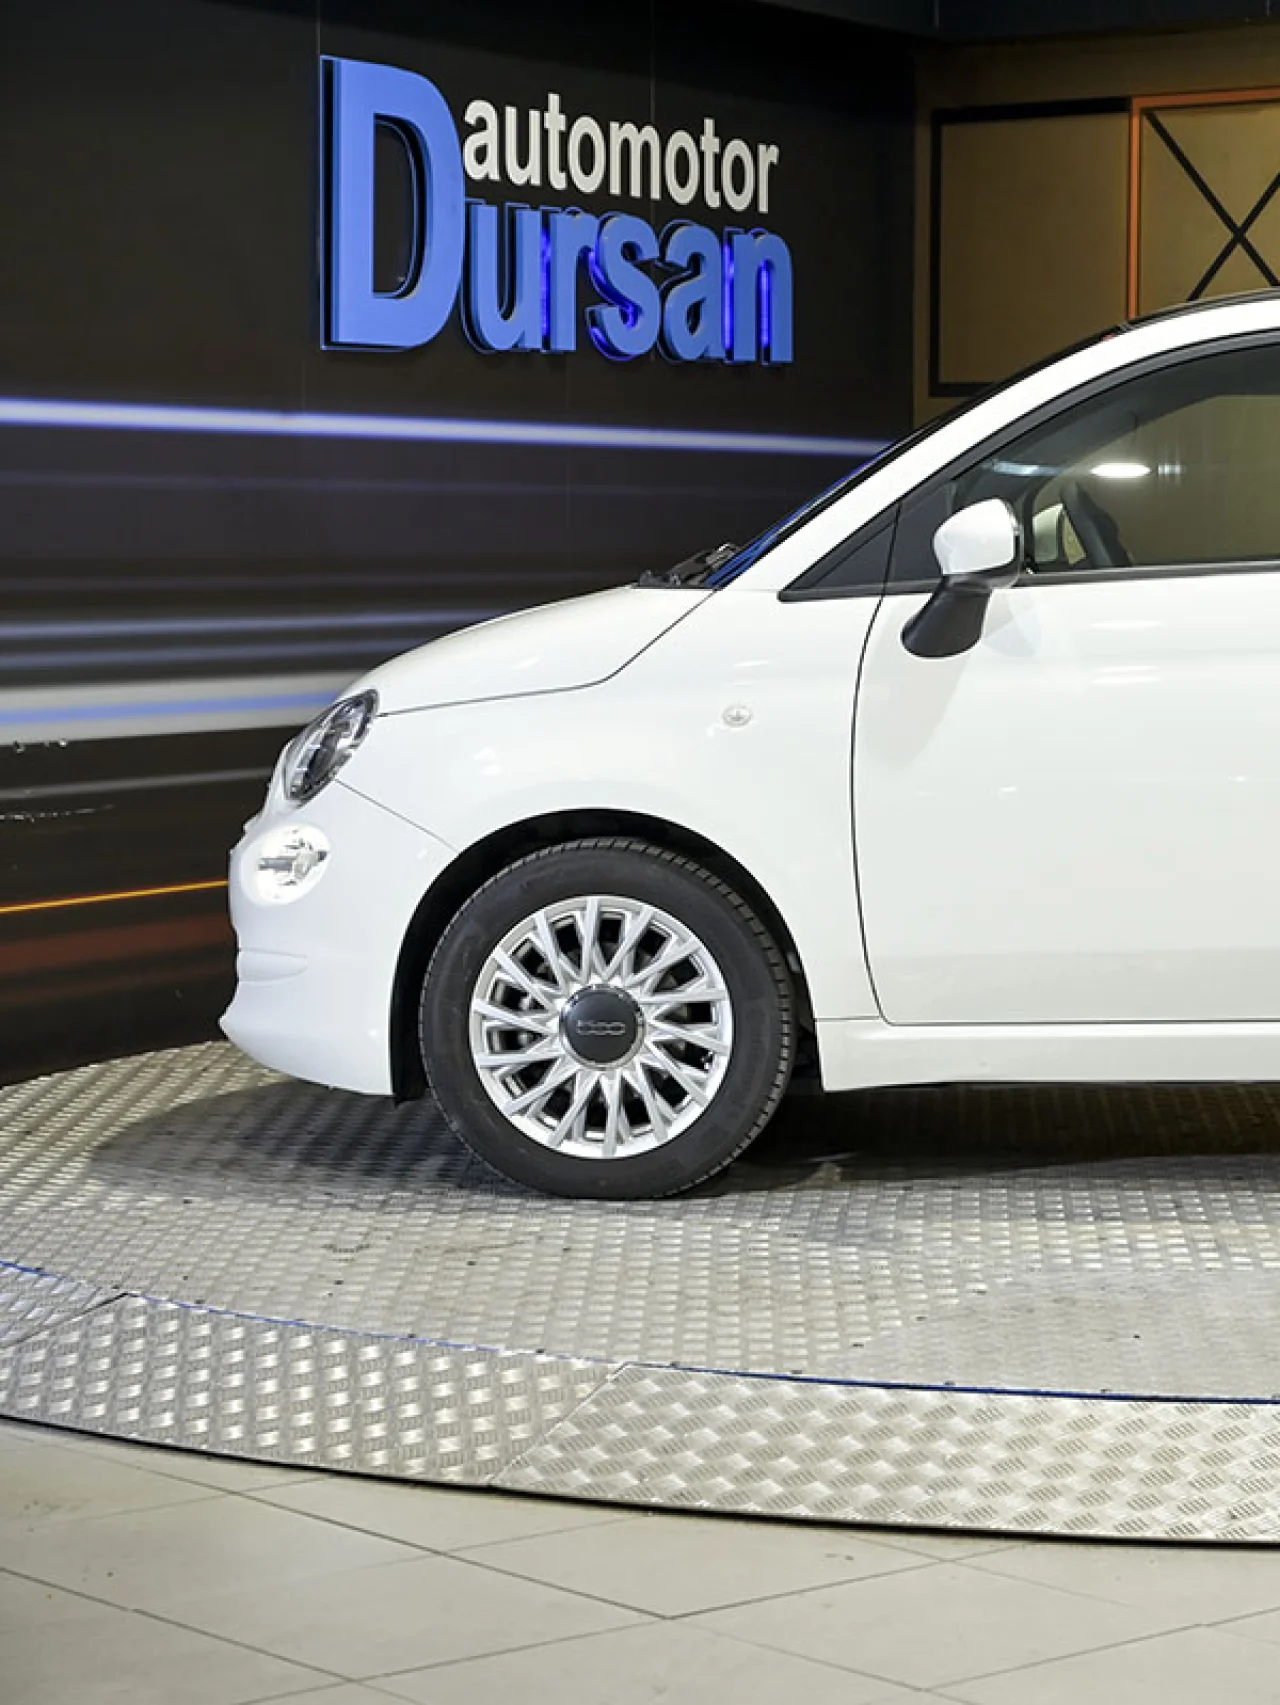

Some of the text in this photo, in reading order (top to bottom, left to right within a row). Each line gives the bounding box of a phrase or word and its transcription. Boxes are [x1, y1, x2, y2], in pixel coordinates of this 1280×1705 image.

[320, 55, 794, 365] Dursan
[463, 93, 779, 213] automotor
[576, 1020, 625, 1036] 500
